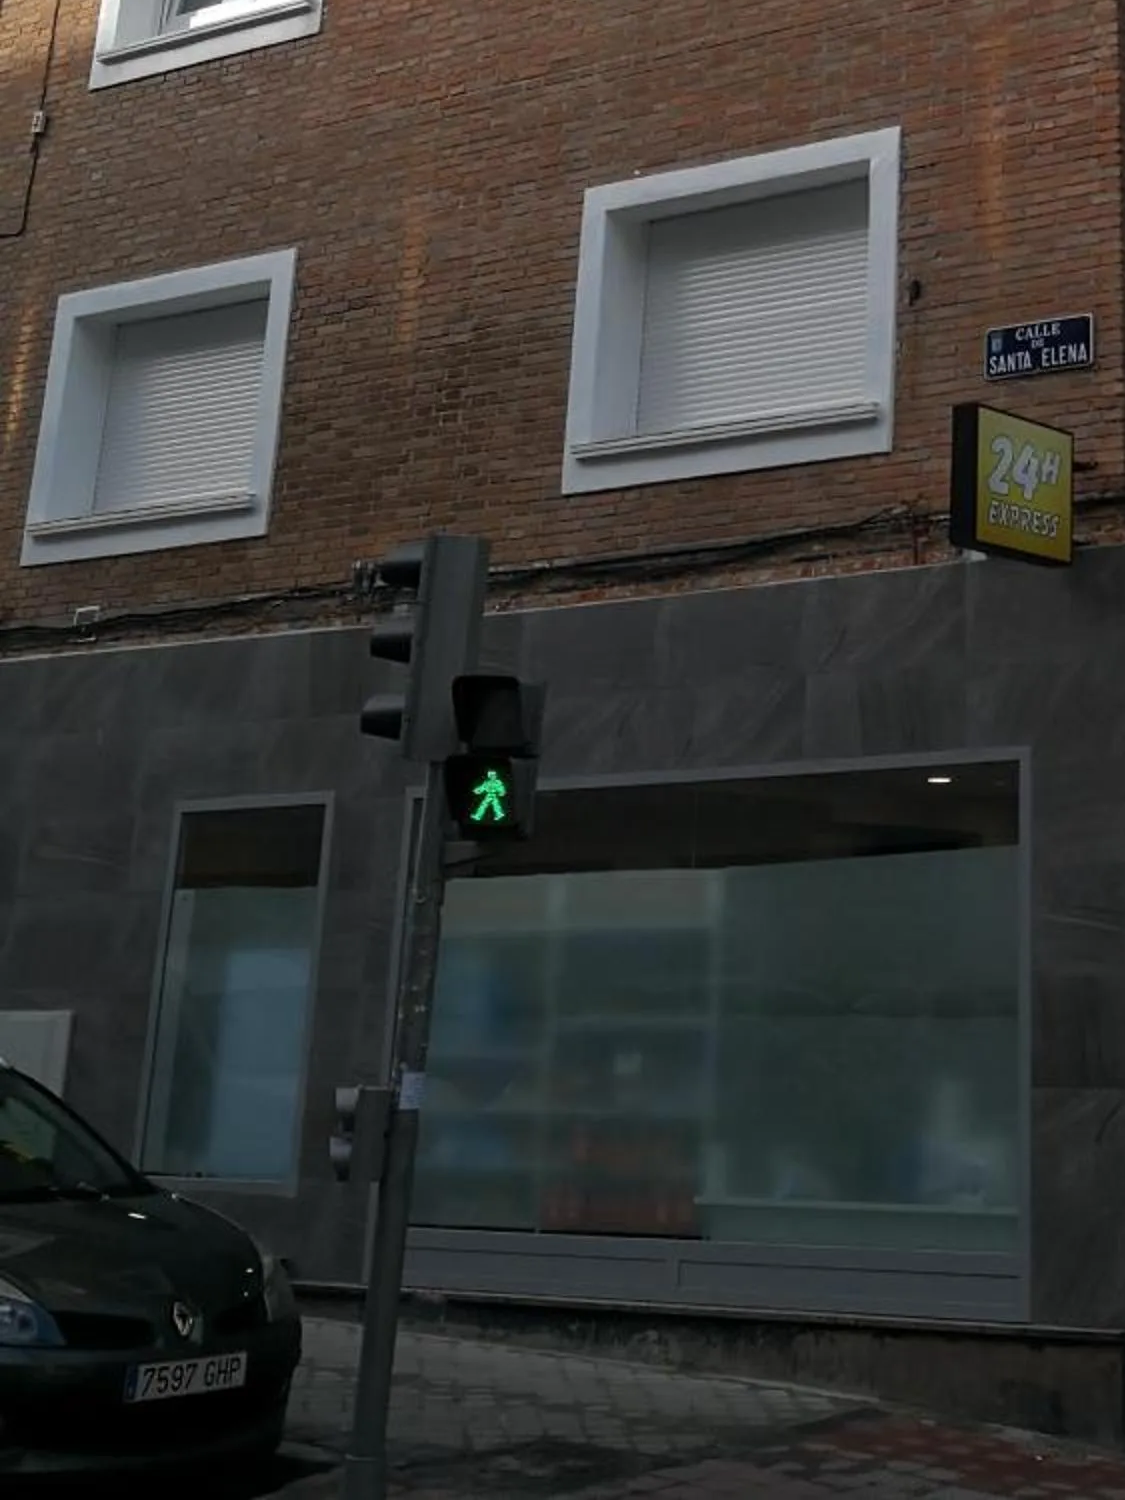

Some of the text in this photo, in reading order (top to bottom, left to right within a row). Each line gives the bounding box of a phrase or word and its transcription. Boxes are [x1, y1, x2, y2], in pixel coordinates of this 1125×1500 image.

[1015, 322, 1061, 341] CALLE
[1030, 338, 1045, 349] DE
[989, 343, 1087, 375] SANTA ELENA
[988, 501, 1060, 538] EXPRESS
[142, 1357, 242, 1395] 7597 GHP
